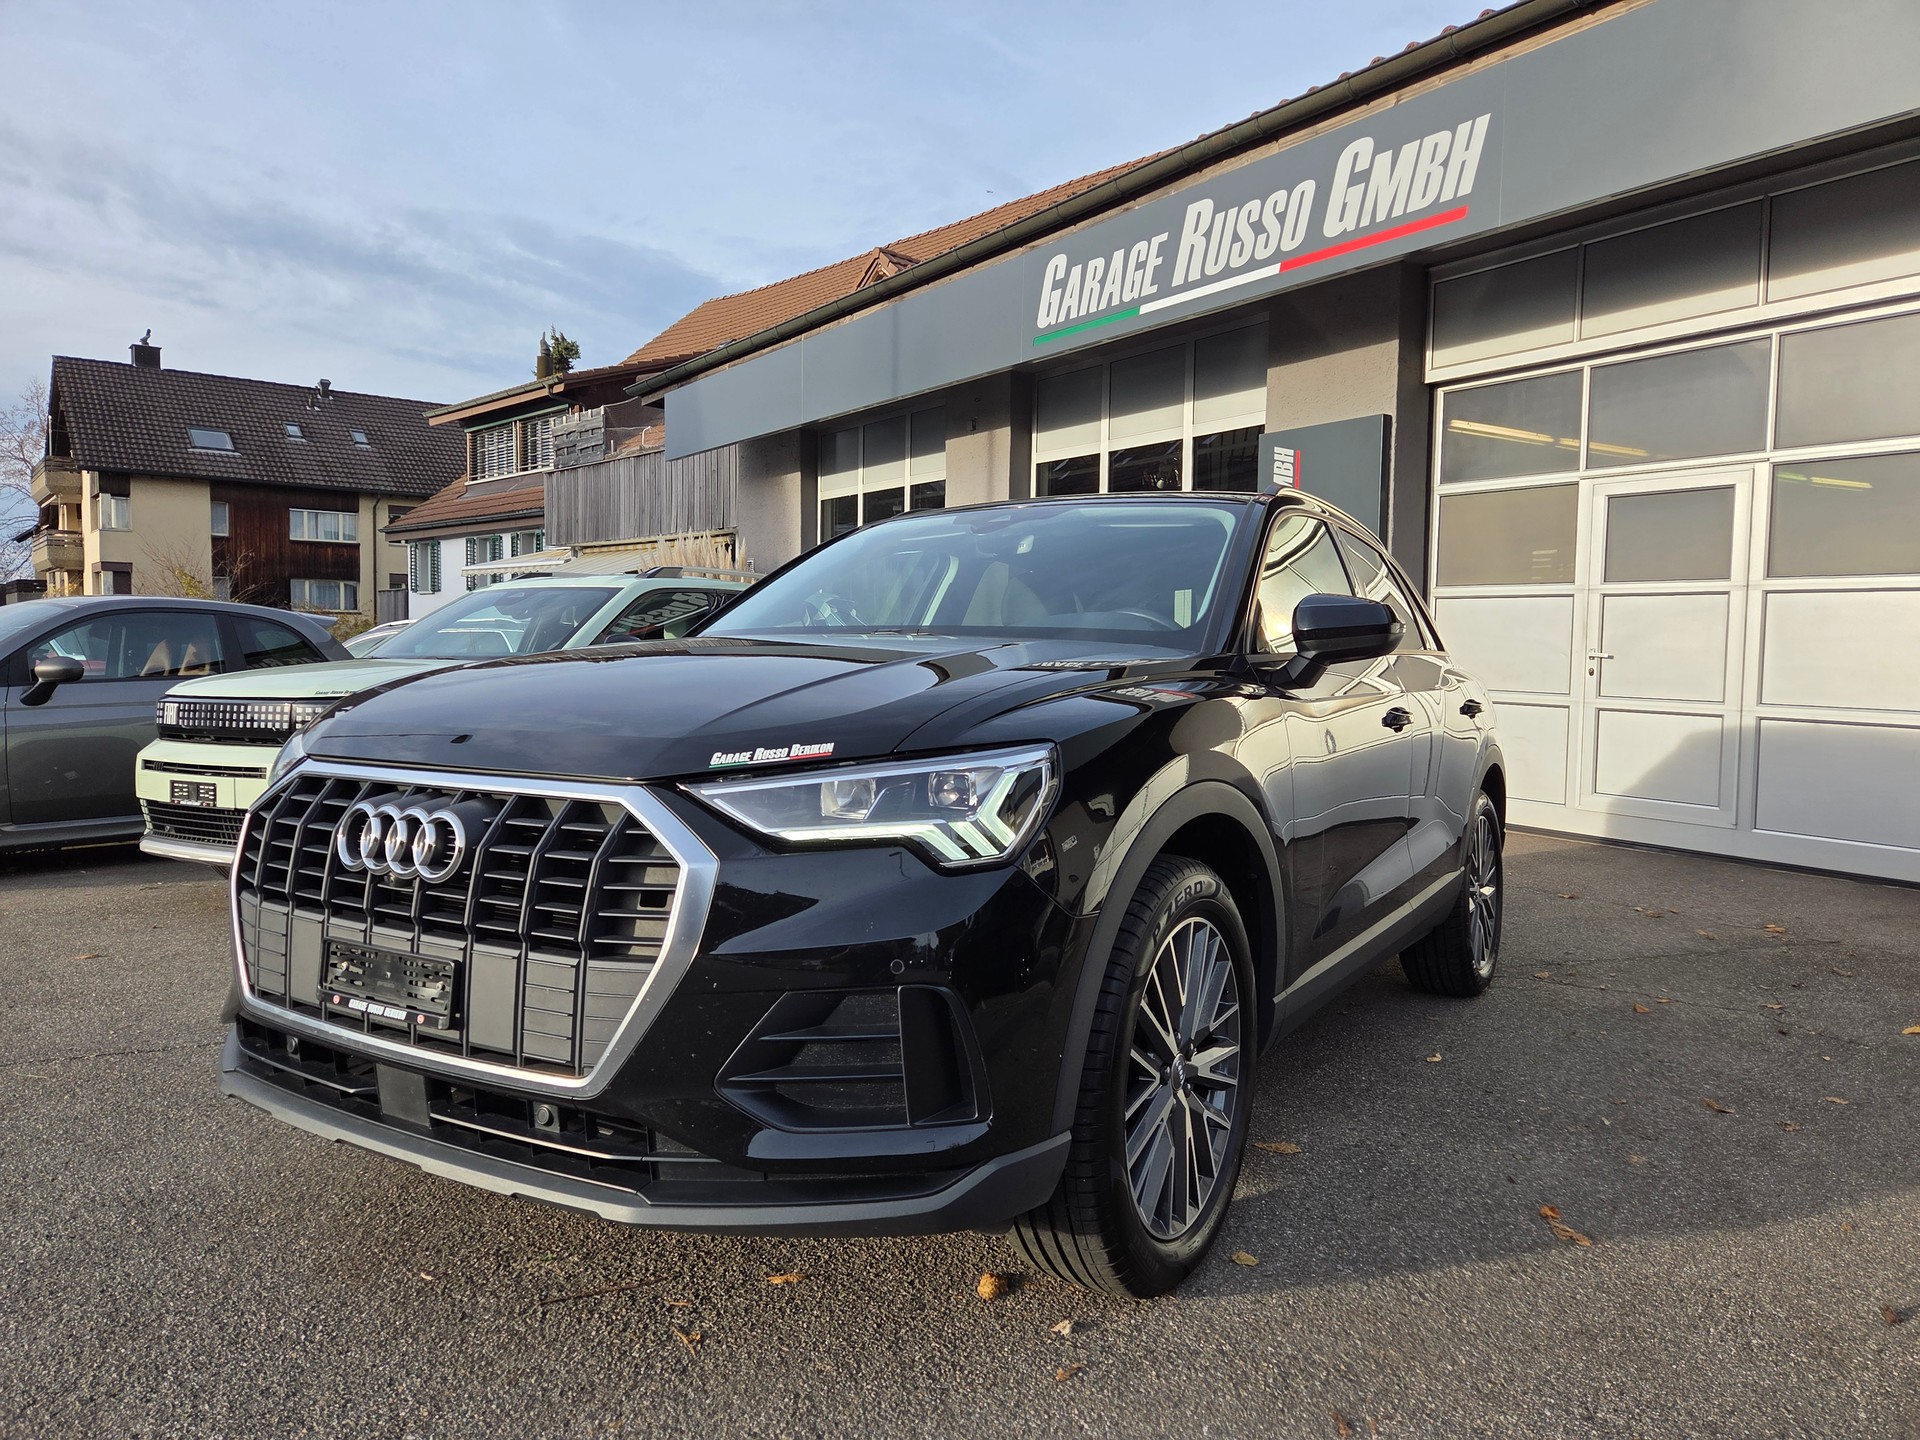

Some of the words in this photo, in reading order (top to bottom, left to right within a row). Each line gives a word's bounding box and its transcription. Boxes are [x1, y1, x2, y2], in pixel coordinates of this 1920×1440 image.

[1036, 232, 1168, 329] GARAGE
[1171, 179, 1316, 287] RUSSO
[1323, 113, 1491, 238] GMBH
[163, 702, 179, 724] FIAT
[710, 751, 753, 765] GARAGE
[753, 747, 789, 761] RUSSO
[789, 742, 835, 757] BERIKON
[1164, 880, 1203, 925] ZERO
